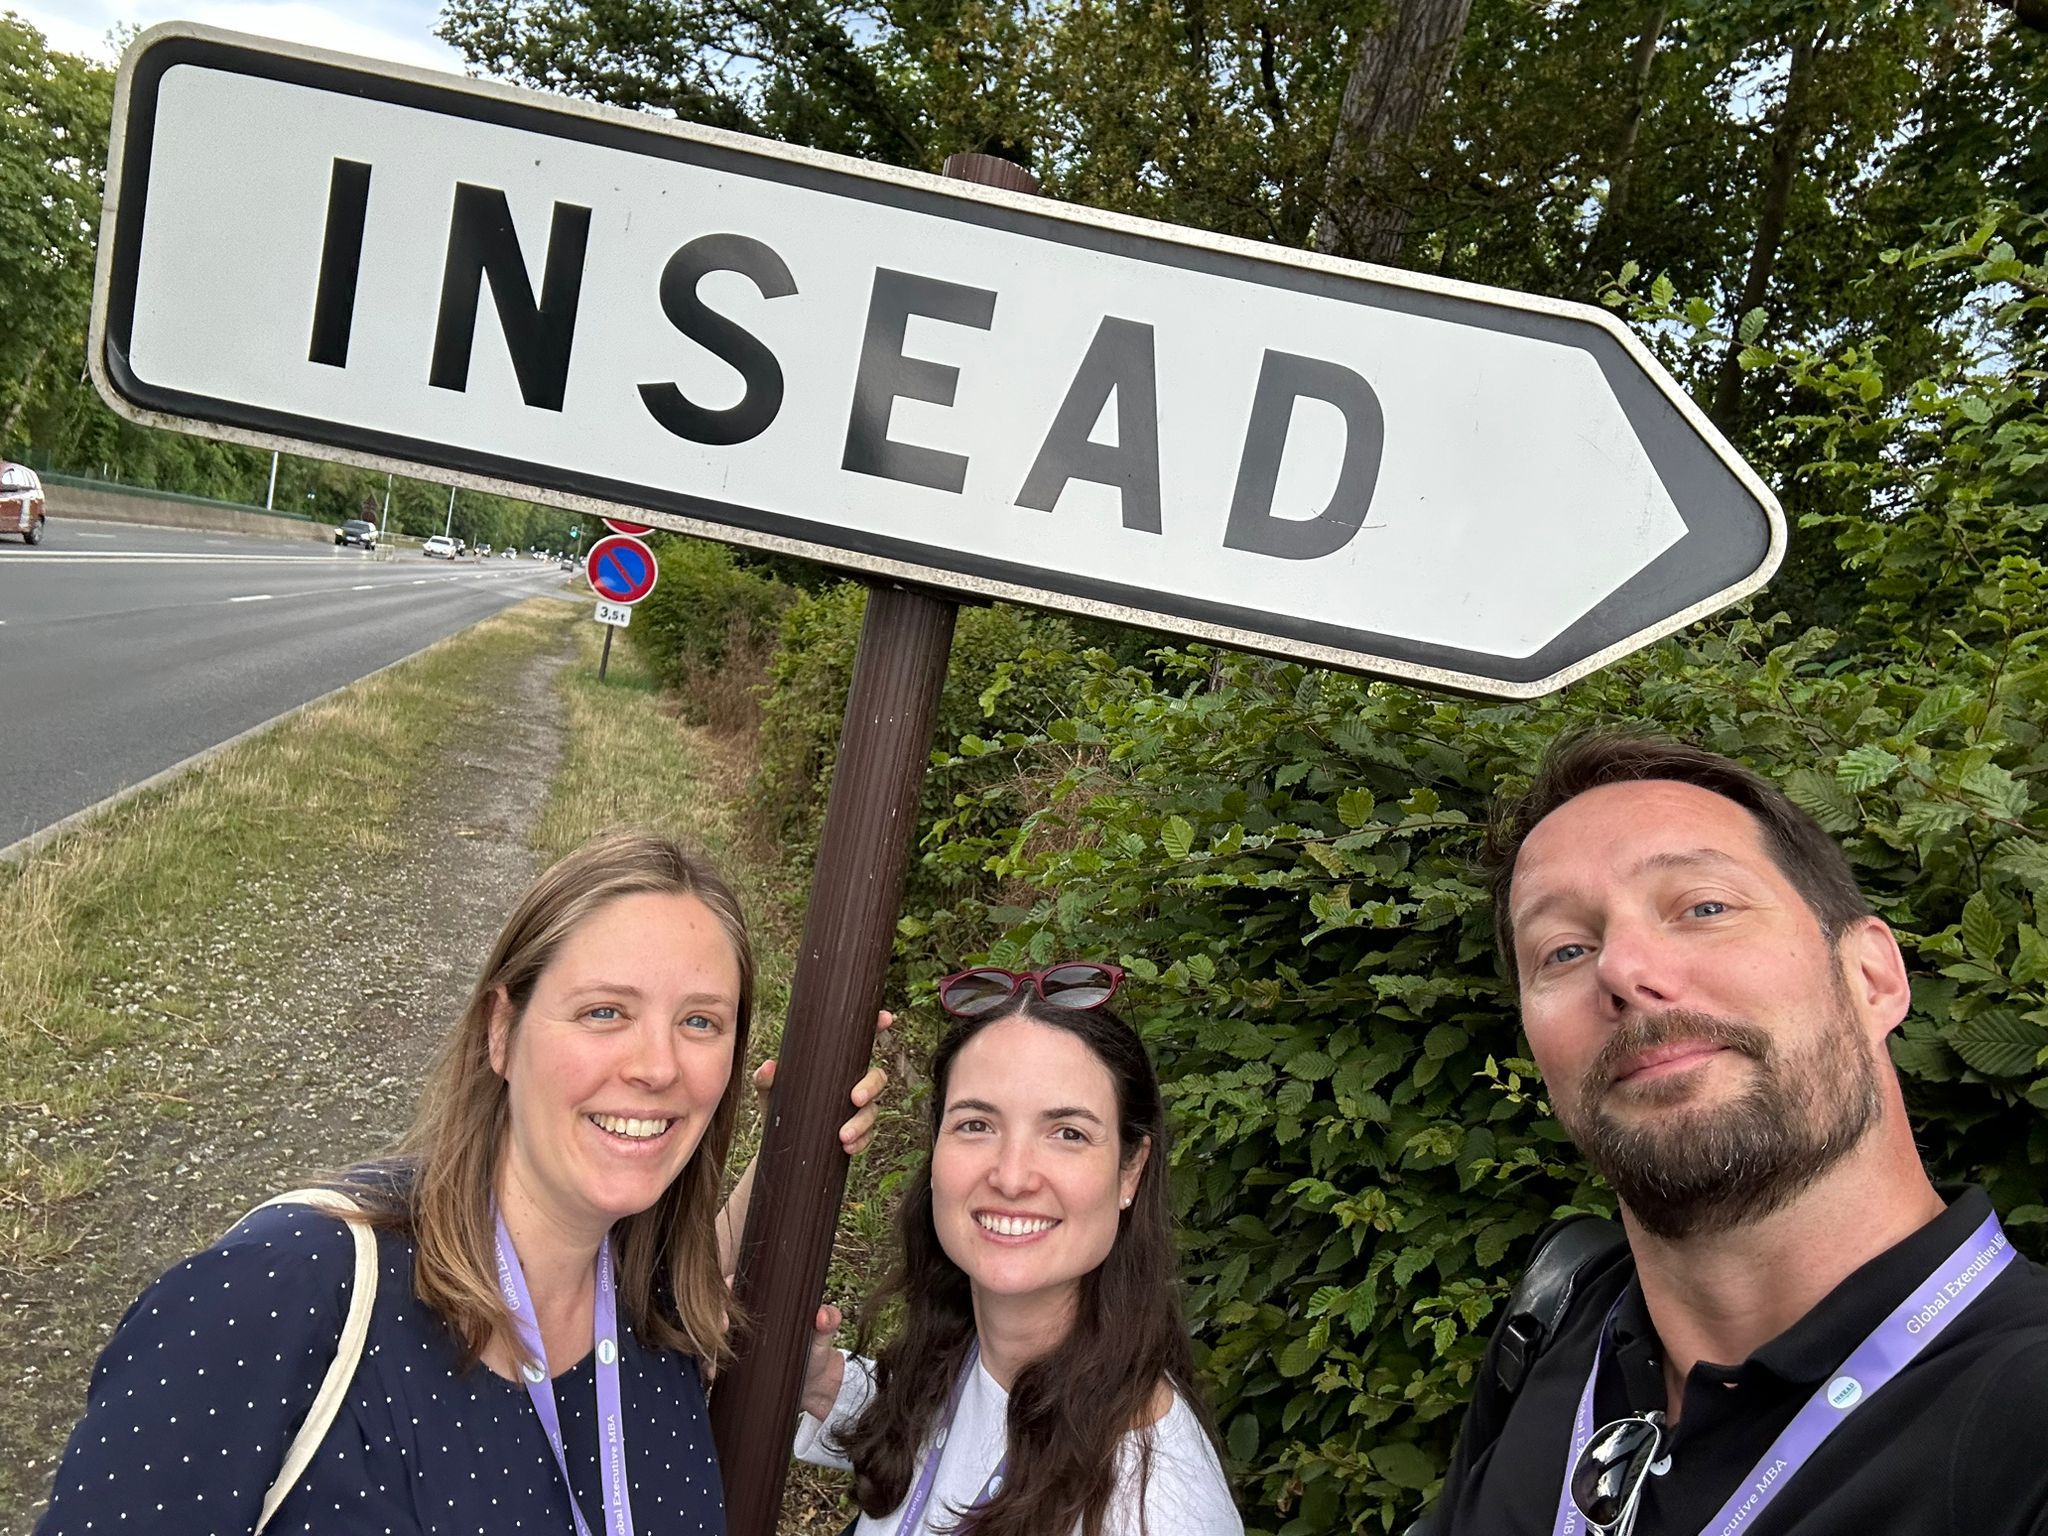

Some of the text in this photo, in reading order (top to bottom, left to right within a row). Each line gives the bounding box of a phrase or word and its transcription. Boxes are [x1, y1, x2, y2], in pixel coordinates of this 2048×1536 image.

[307, 157, 1386, 560] INSEAD
[499, 1272, 521, 1311] Global
[601, 1256, 610, 1292] Global
[1906, 1291, 1950, 1334] Global
[1944, 1245, 1999, 1298] Executive
[607, 1413, 617, 1443] MBA
[612, 1445, 622, 1507] Executive
[1755, 1459, 1788, 1494] MBA
[1563, 1511, 1578, 1536] MB
